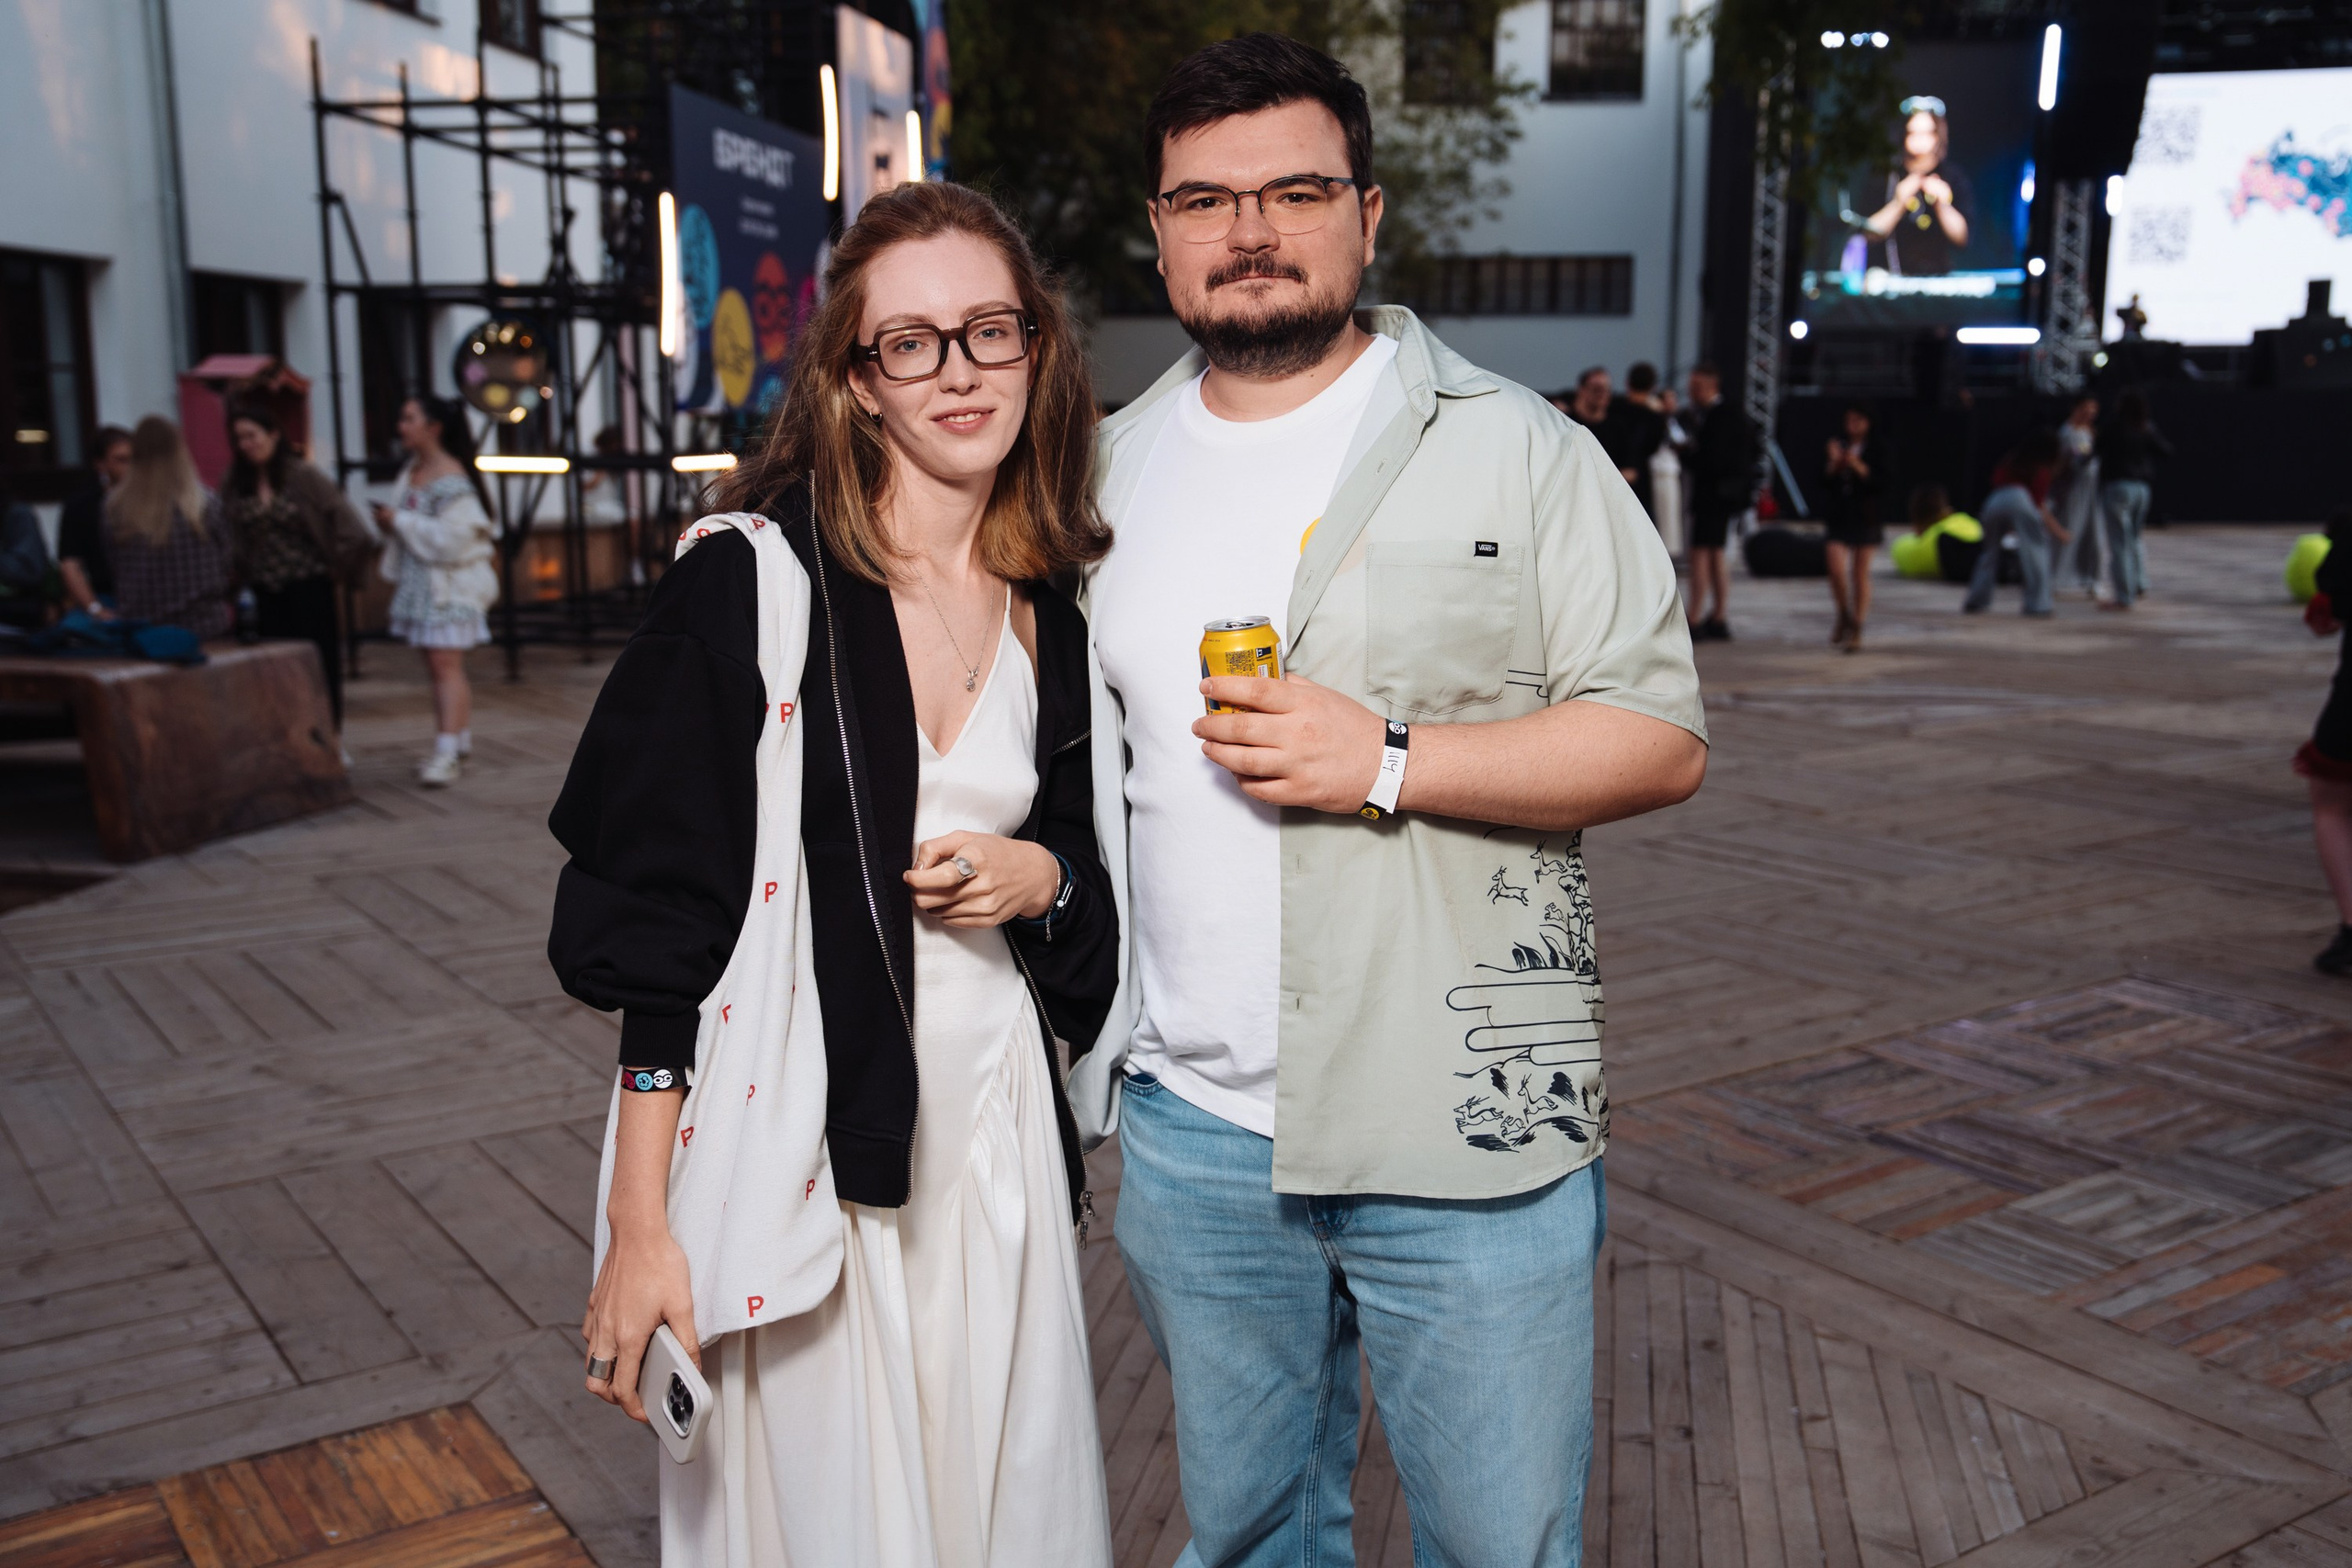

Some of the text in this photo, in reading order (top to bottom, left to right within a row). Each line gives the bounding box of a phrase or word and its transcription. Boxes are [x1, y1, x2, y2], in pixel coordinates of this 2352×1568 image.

[1477, 544, 1493, 552] VANS
[764, 882, 778, 903] P
[680, 1126, 695, 1148] P
[748, 1296, 764, 1318] P
